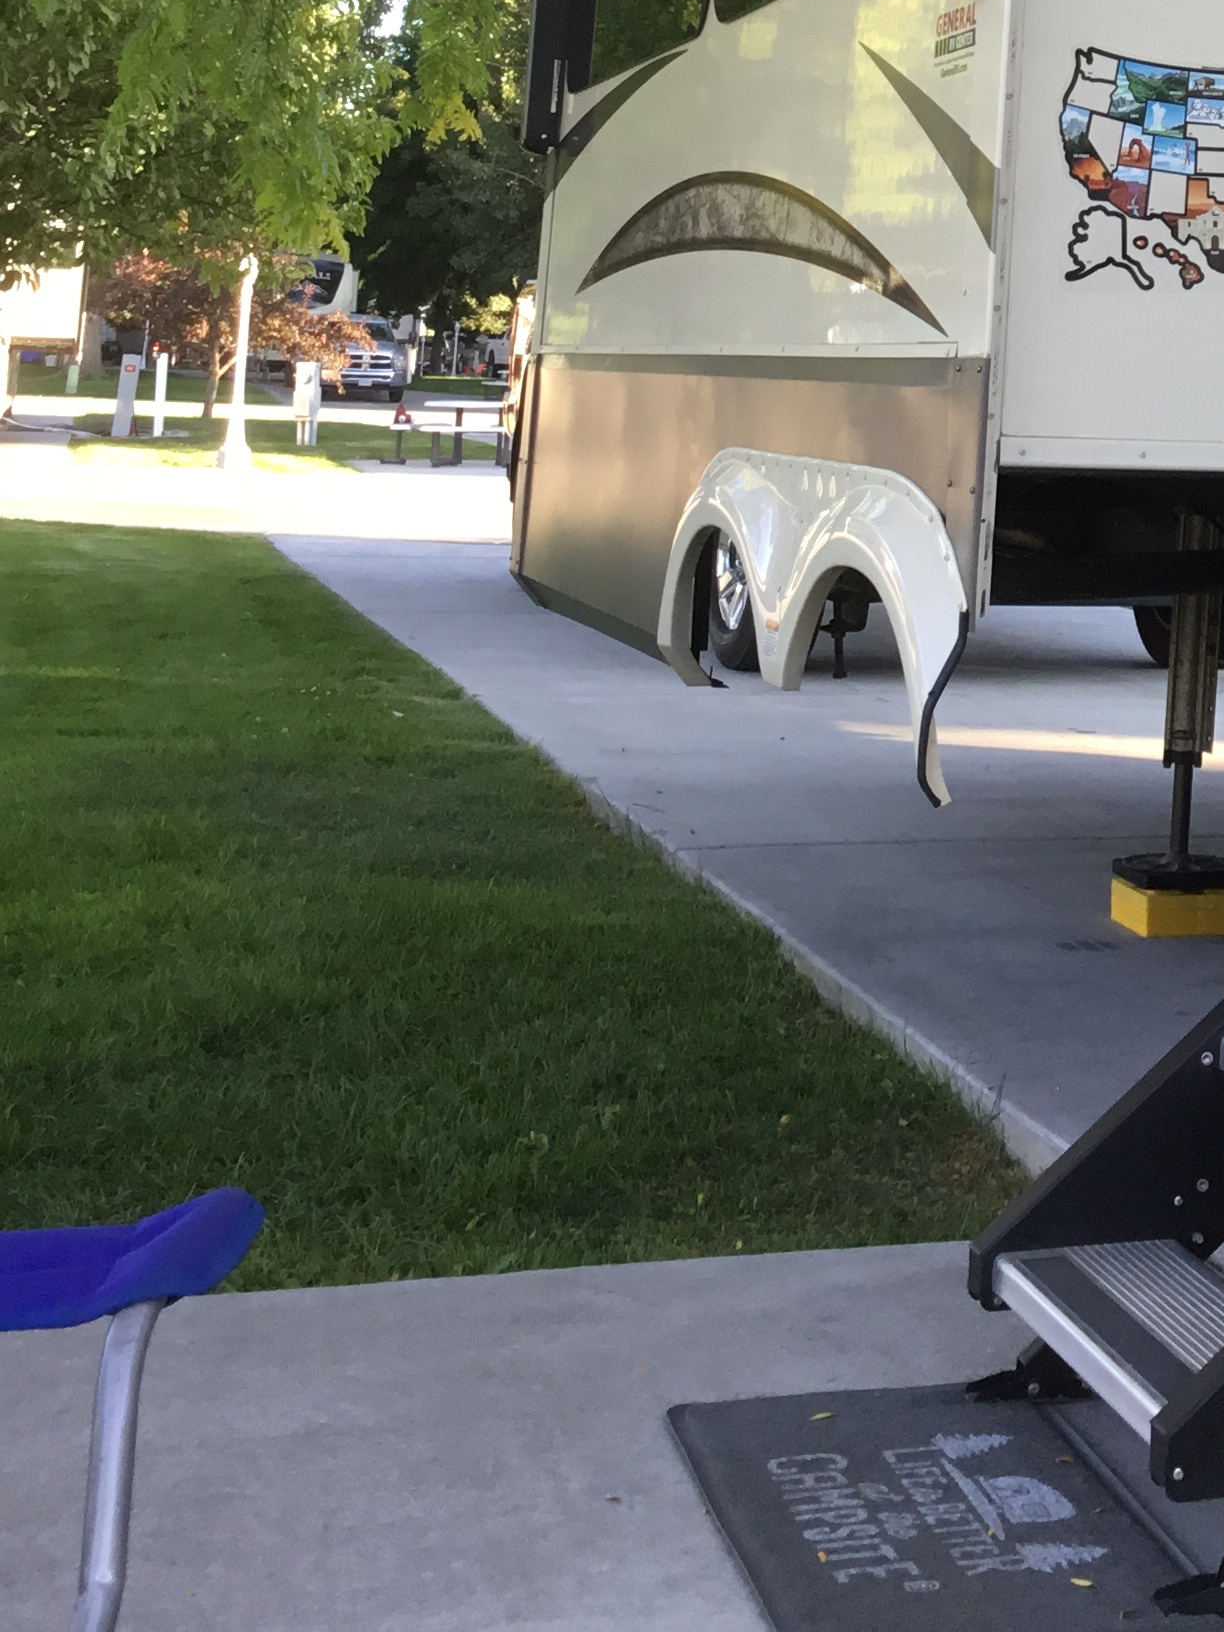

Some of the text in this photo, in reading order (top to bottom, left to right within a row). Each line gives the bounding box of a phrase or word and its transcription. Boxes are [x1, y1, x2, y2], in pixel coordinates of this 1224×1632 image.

[936, 2, 976, 37] GENERAL
[766, 1452, 920, 1584] CAMPSITE
[882, 1446, 948, 1489] LIFE
[917, 1502, 1028, 1576] BETTER
